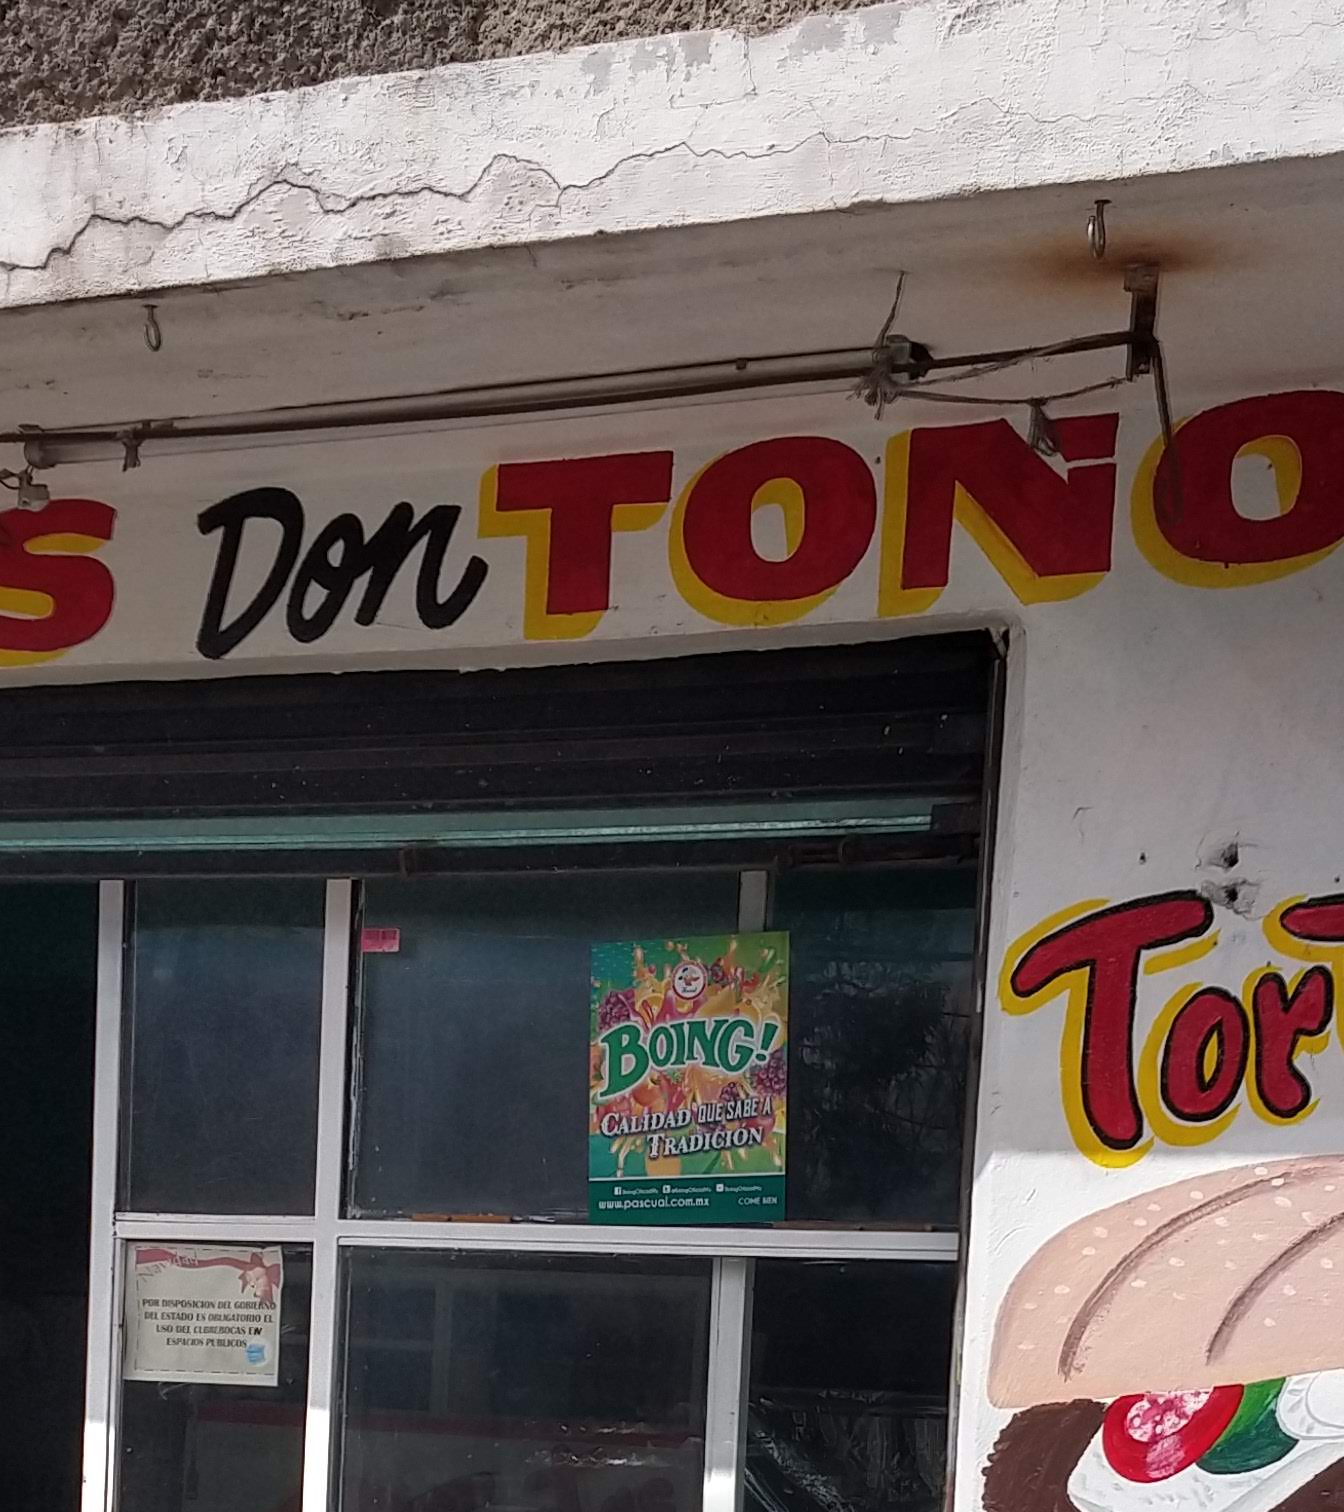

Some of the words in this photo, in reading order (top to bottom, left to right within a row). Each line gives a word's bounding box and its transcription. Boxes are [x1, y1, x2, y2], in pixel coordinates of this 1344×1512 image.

[197, 486, 490, 660] Don
[599, 1018, 780, 1098] BOING!
[697, 1104, 723, 1124] QUE
[726, 1098, 758, 1120] SABE
[762, 1099, 772, 1116] A
[598, 1197, 709, 1210] www.pascual.com.mx
